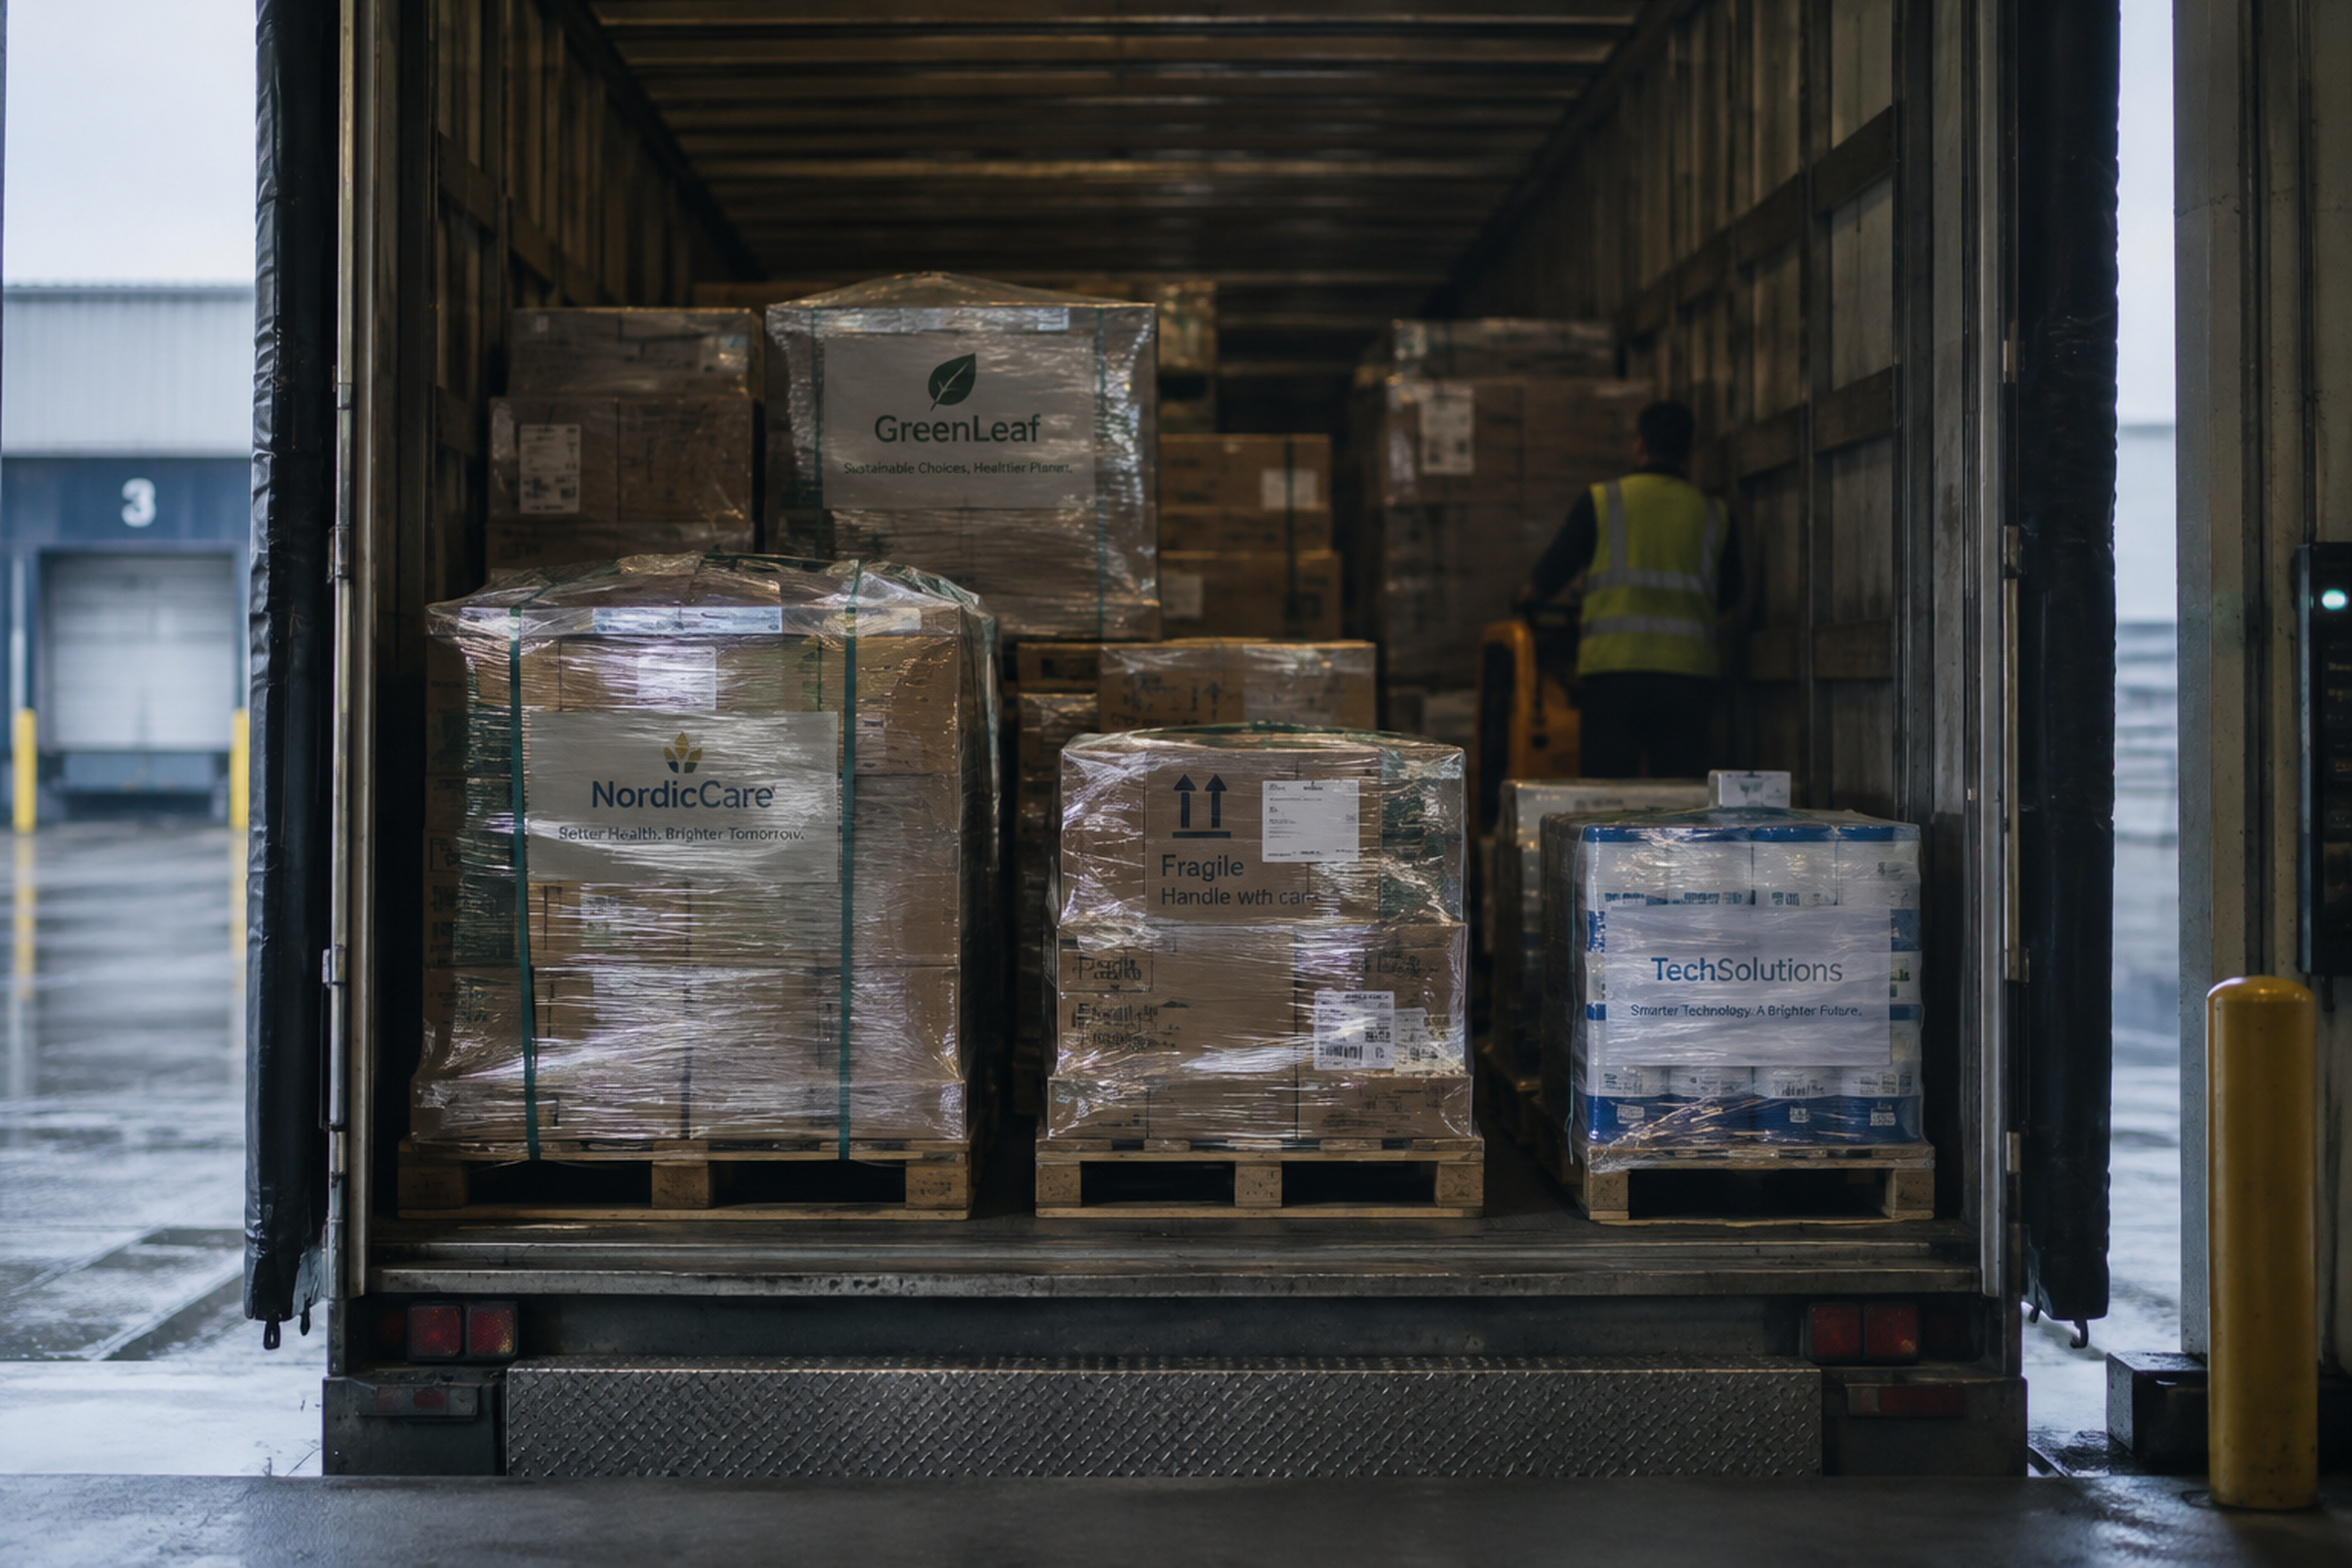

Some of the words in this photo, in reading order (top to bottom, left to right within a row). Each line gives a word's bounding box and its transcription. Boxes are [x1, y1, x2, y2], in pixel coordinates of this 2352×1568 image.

[874, 413, 1041, 443] GreenLeaf
[918, 462, 970, 475] Choices,
[122, 478, 156, 527] 3
[592, 780, 774, 809] NordicCare
[665, 826, 723, 843] Brighter
[1161, 854, 1244, 883] Fragile
[1161, 887, 1231, 905] Handle
[1650, 957, 1843, 982] TechSolutions
[1630, 1004, 1678, 1016] Smarter
[1755, 1005, 1766, 1016] A
[1768, 1004, 1815, 1019] Brighter
